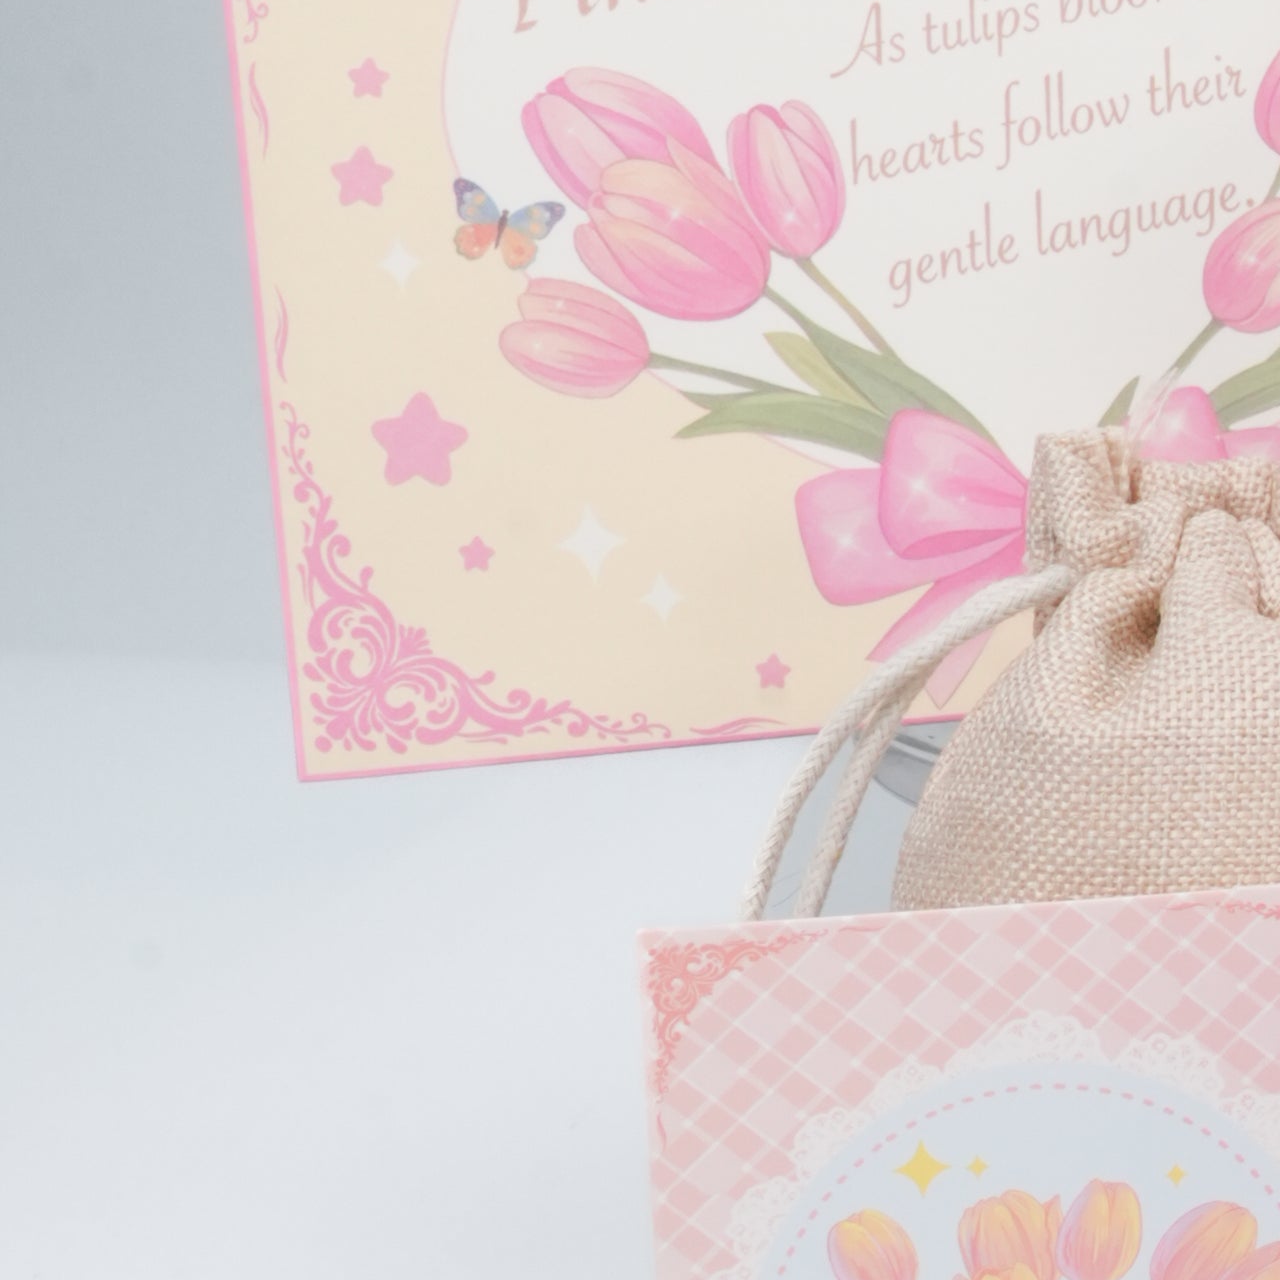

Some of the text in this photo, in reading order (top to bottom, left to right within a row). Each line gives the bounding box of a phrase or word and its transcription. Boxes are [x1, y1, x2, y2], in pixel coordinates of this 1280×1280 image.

[830, 3, 906, 78] As
[851, 48, 1247, 185] hearts follow their
[889, 181, 1256, 308] gentle language.
